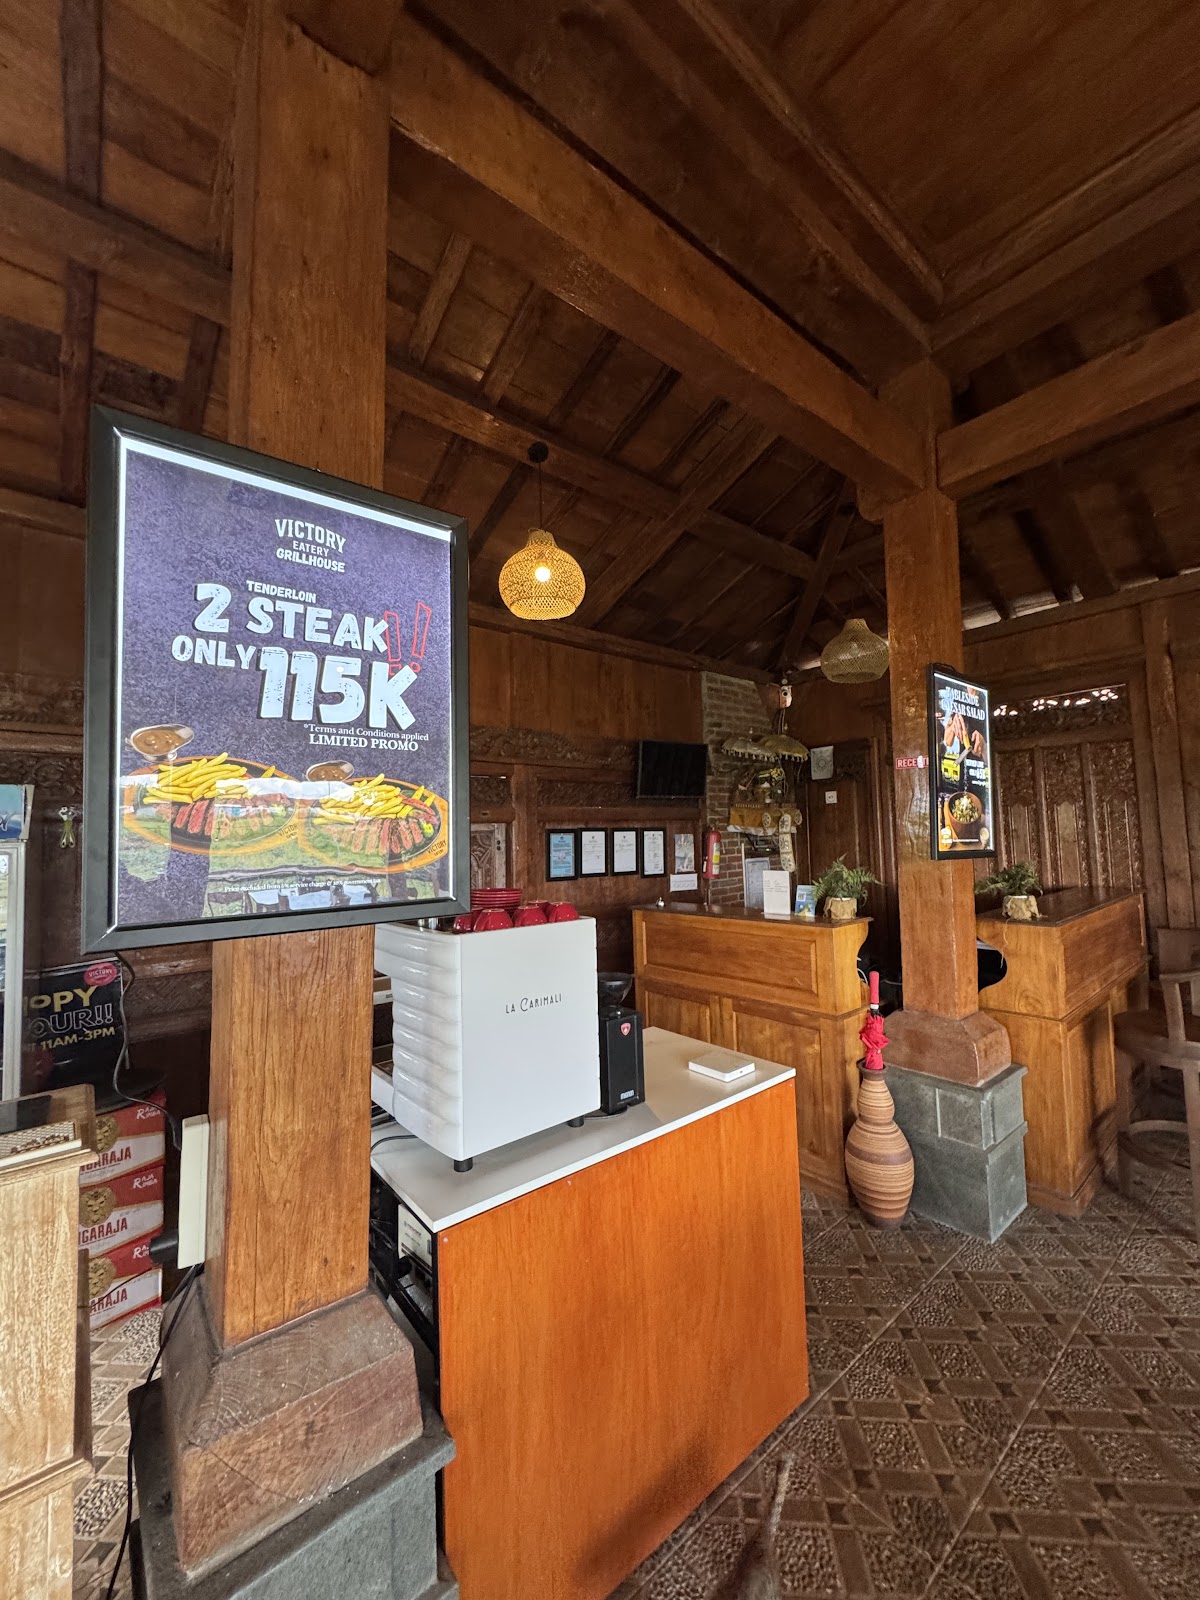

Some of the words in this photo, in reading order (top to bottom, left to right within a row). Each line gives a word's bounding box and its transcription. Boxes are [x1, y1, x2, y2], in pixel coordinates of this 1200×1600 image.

[275, 519, 346, 553] VICTORY
[293, 540, 329, 557] EATERY
[276, 548, 345, 573] GRILLHOUSE
[246, 580, 317, 604] TENDERLOIN
[194, 583, 231, 633] 2
[171, 635, 256, 669] ONLY
[259, 646, 418, 730] 115K
[967, 705, 985, 721] SALAD
[309, 733, 368, 748] LIMITED
[370, 738, 419, 751] PROMO
[338, 727, 354, 736] and
[356, 727, 400, 739] Conditions
[401, 732, 429, 742] applied
[89, 969, 113, 978] VICTORY
[505, 1003, 516, 1014] LA
[40, 1026, 116, 1051] 11AM-3PM
